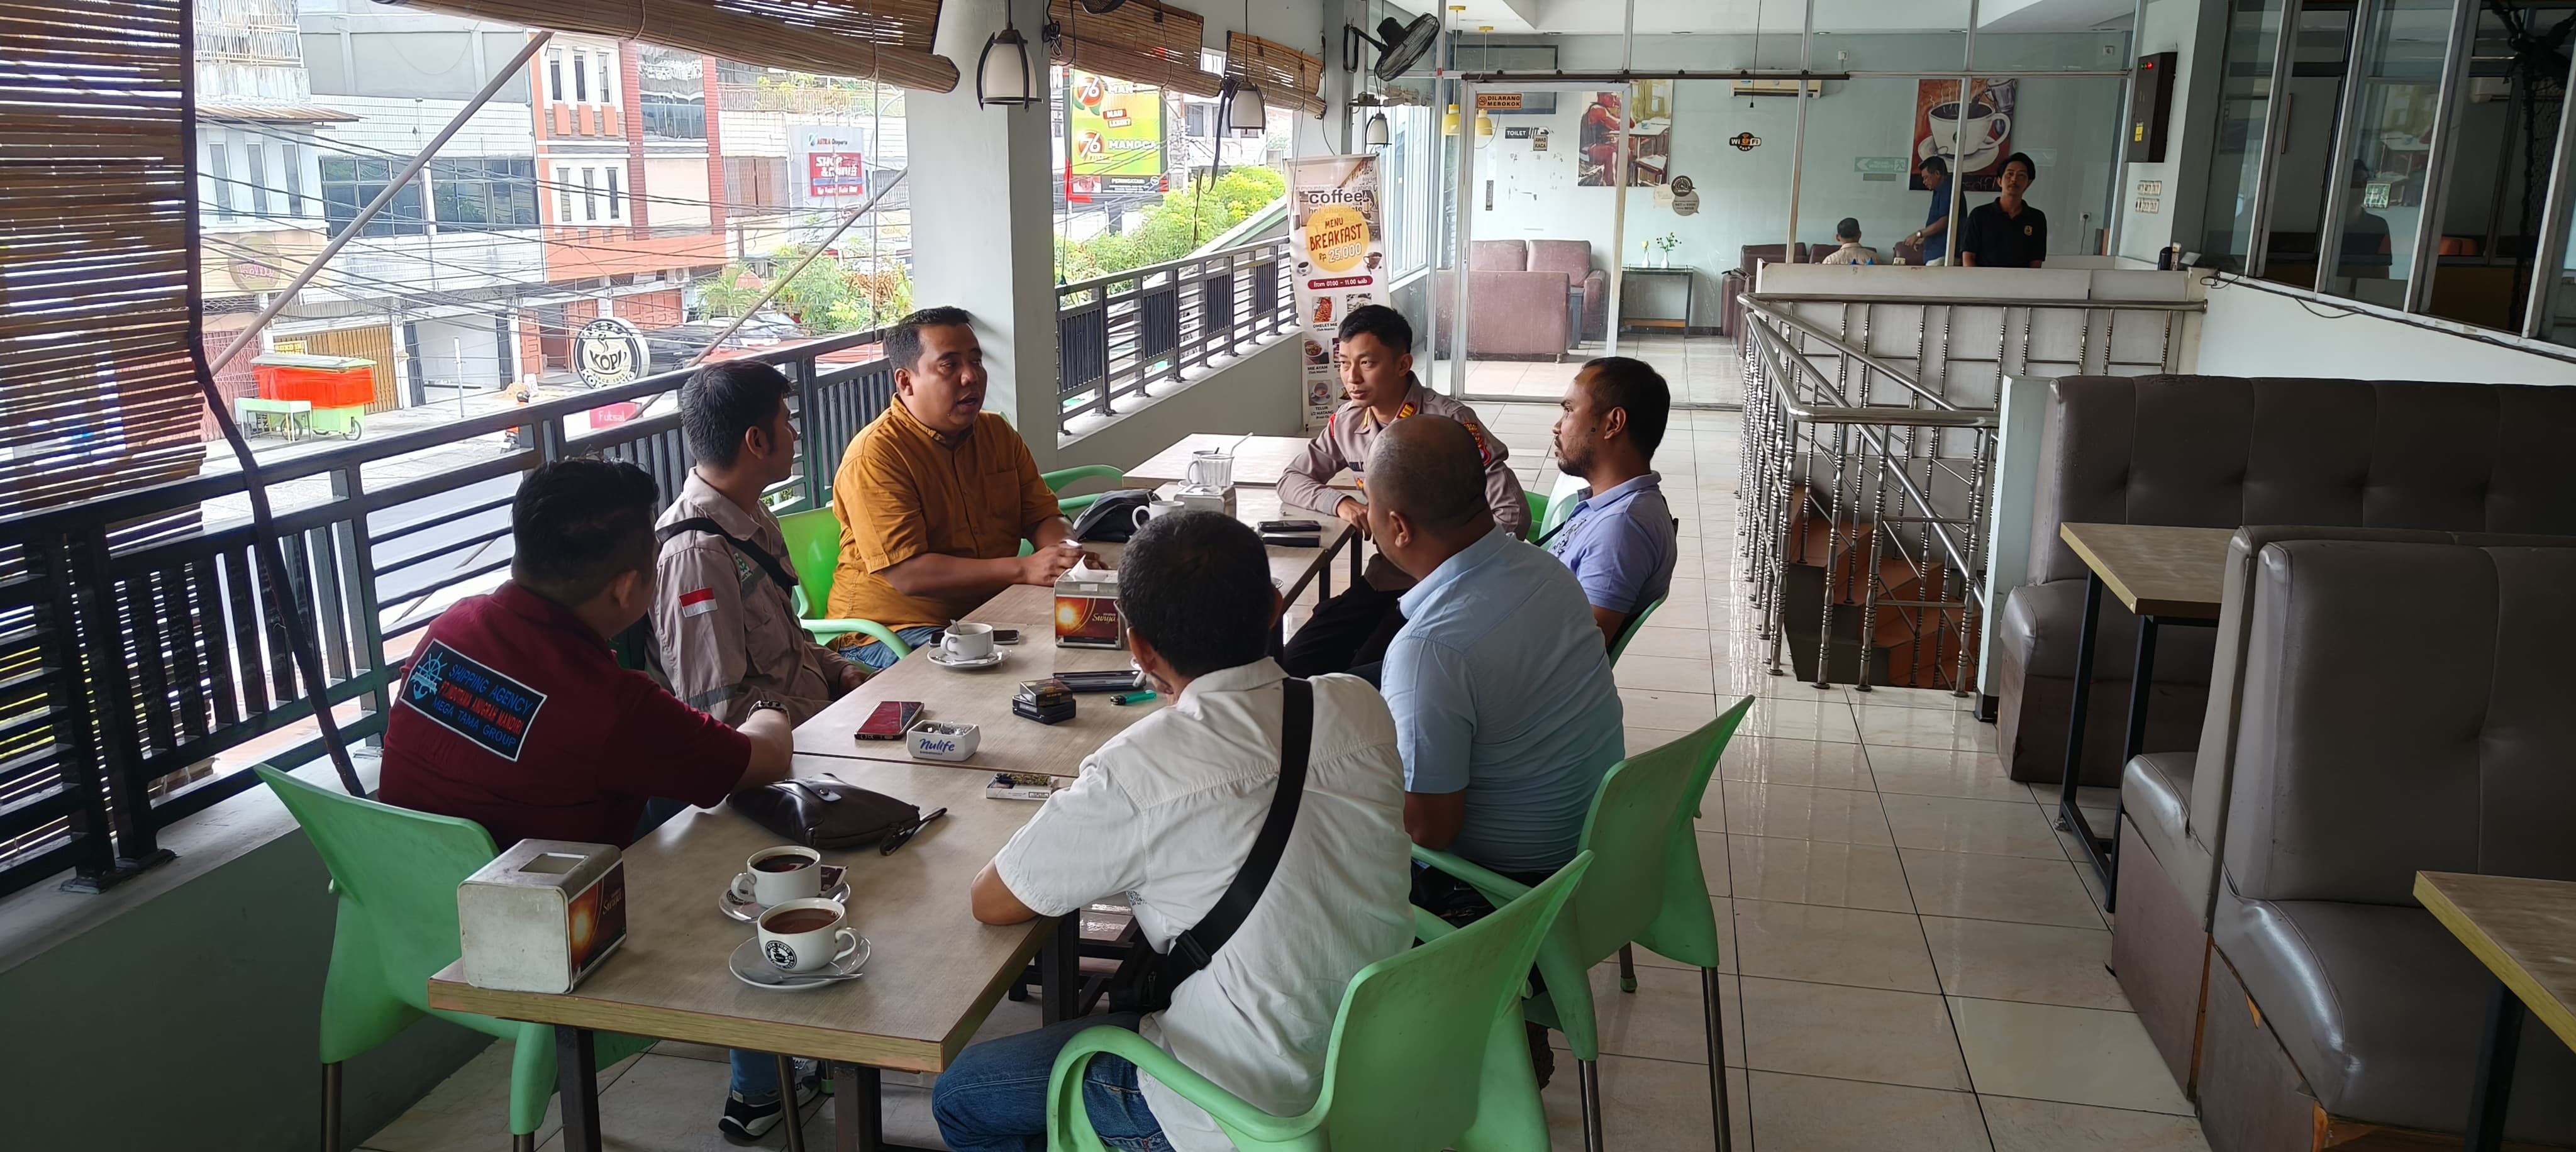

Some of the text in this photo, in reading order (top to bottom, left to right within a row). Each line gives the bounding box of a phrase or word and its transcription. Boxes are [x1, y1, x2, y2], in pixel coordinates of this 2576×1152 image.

[1077, 77, 1100, 103] 76
[1078, 132, 1101, 158] 76
[1309, 189, 1362, 204] coffee
[1325, 218, 1343, 229] MENU
[1310, 223, 1362, 251] BREAKFAST
[1319, 242, 1362, 263] Rp 25.000
[589, 349, 622, 371] KOPI
[599, 411, 626, 422] Futsal
[448, 664, 489, 693] SHIPPING
[490, 684, 533, 714] AGENCY
[432, 697, 516, 747] MEGA TAMA GROUP
